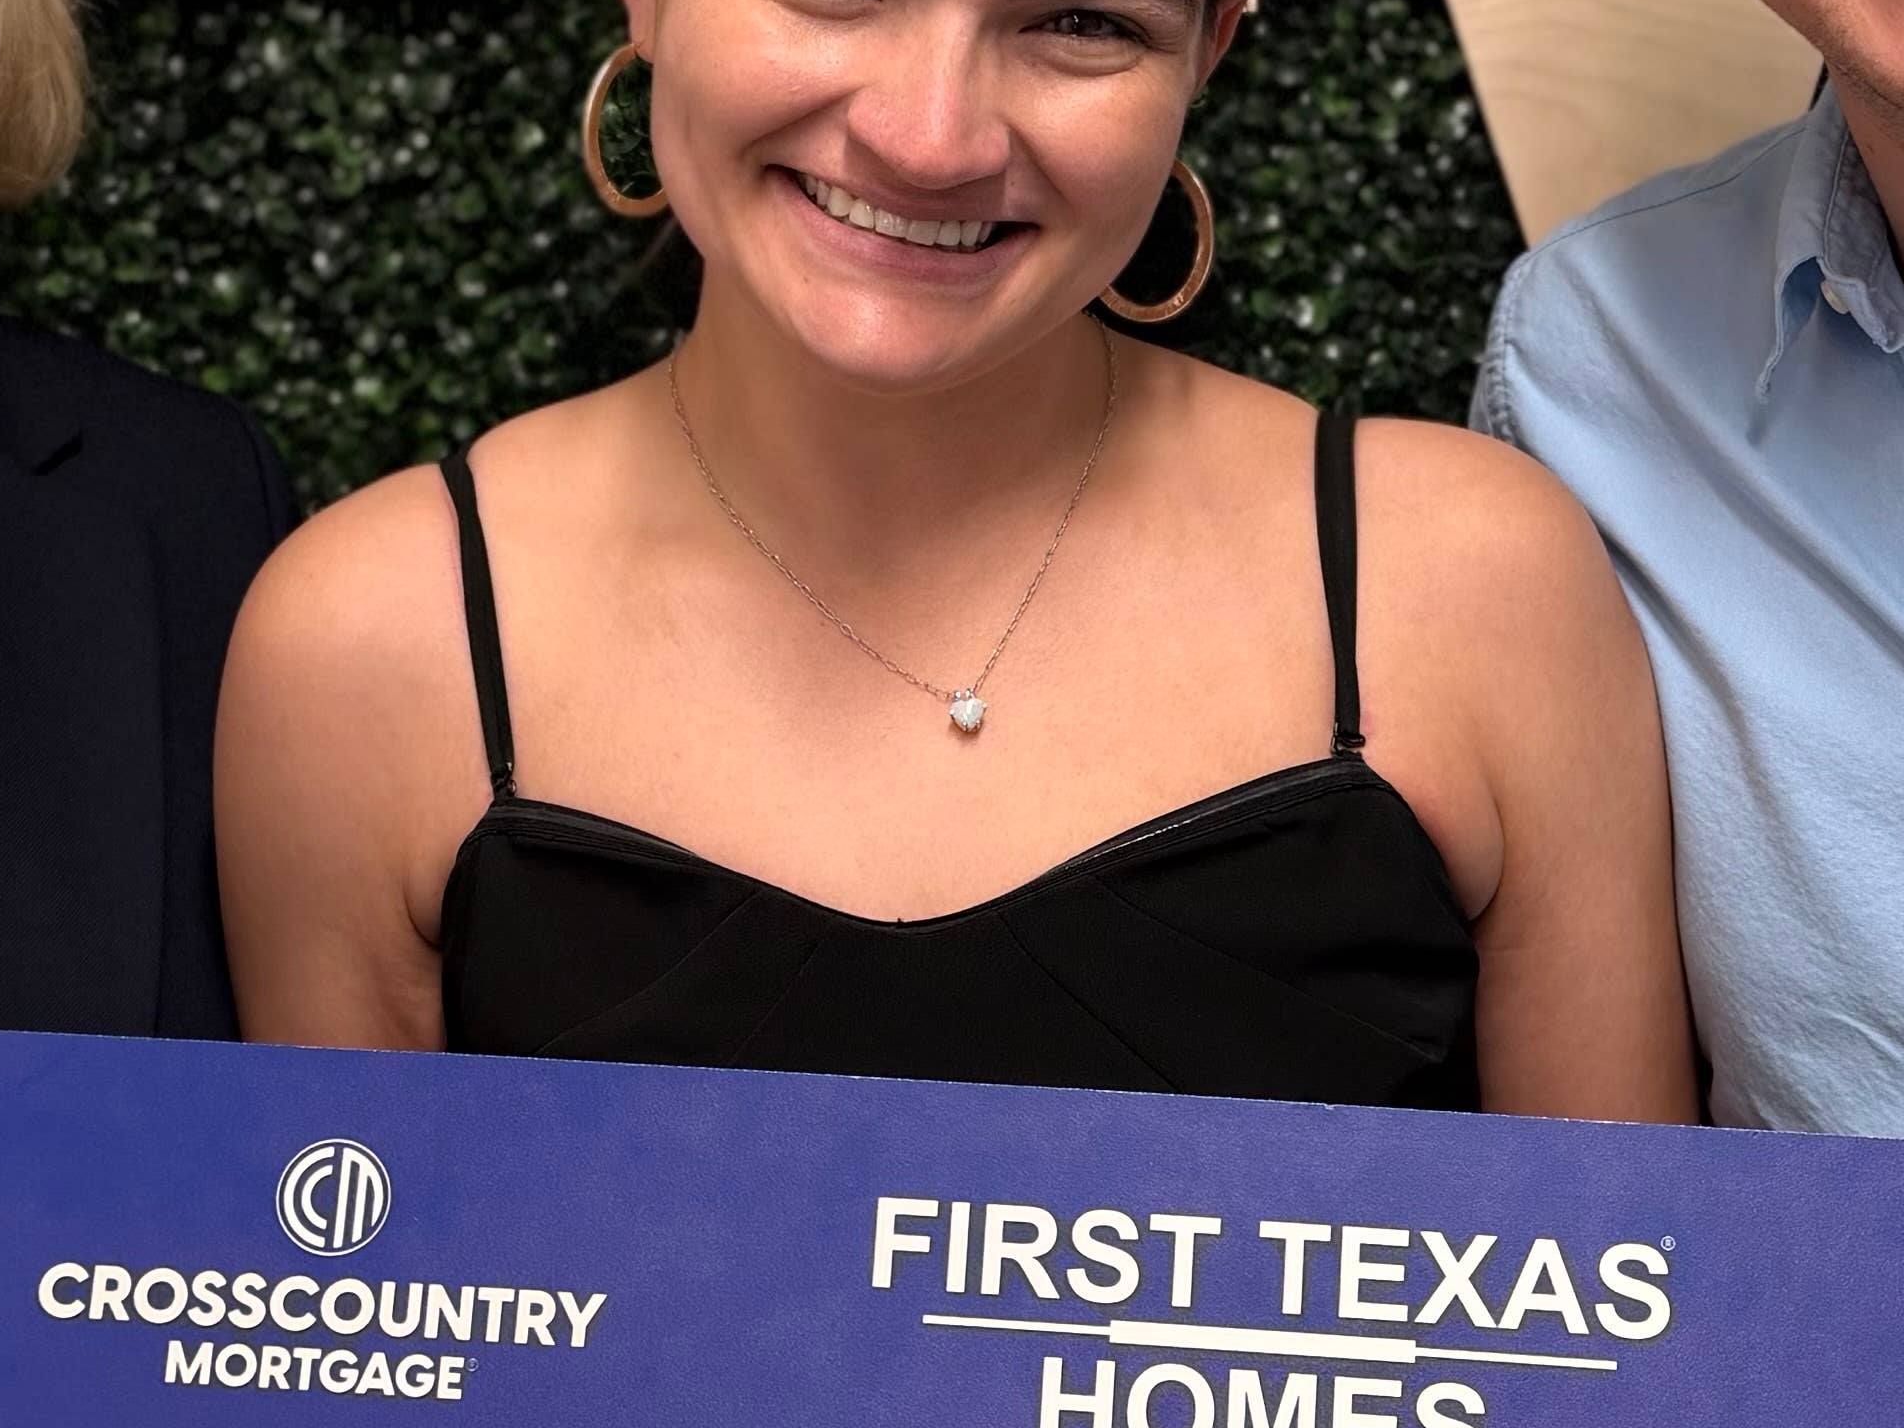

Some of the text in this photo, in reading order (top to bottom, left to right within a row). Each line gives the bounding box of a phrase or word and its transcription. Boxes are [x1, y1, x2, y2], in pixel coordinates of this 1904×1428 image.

[871, 1196, 1222, 1309] FIRST
[38, 1261, 608, 1349] CROSSCOUNTRY
[163, 1339, 465, 1401] MORTGAGE
